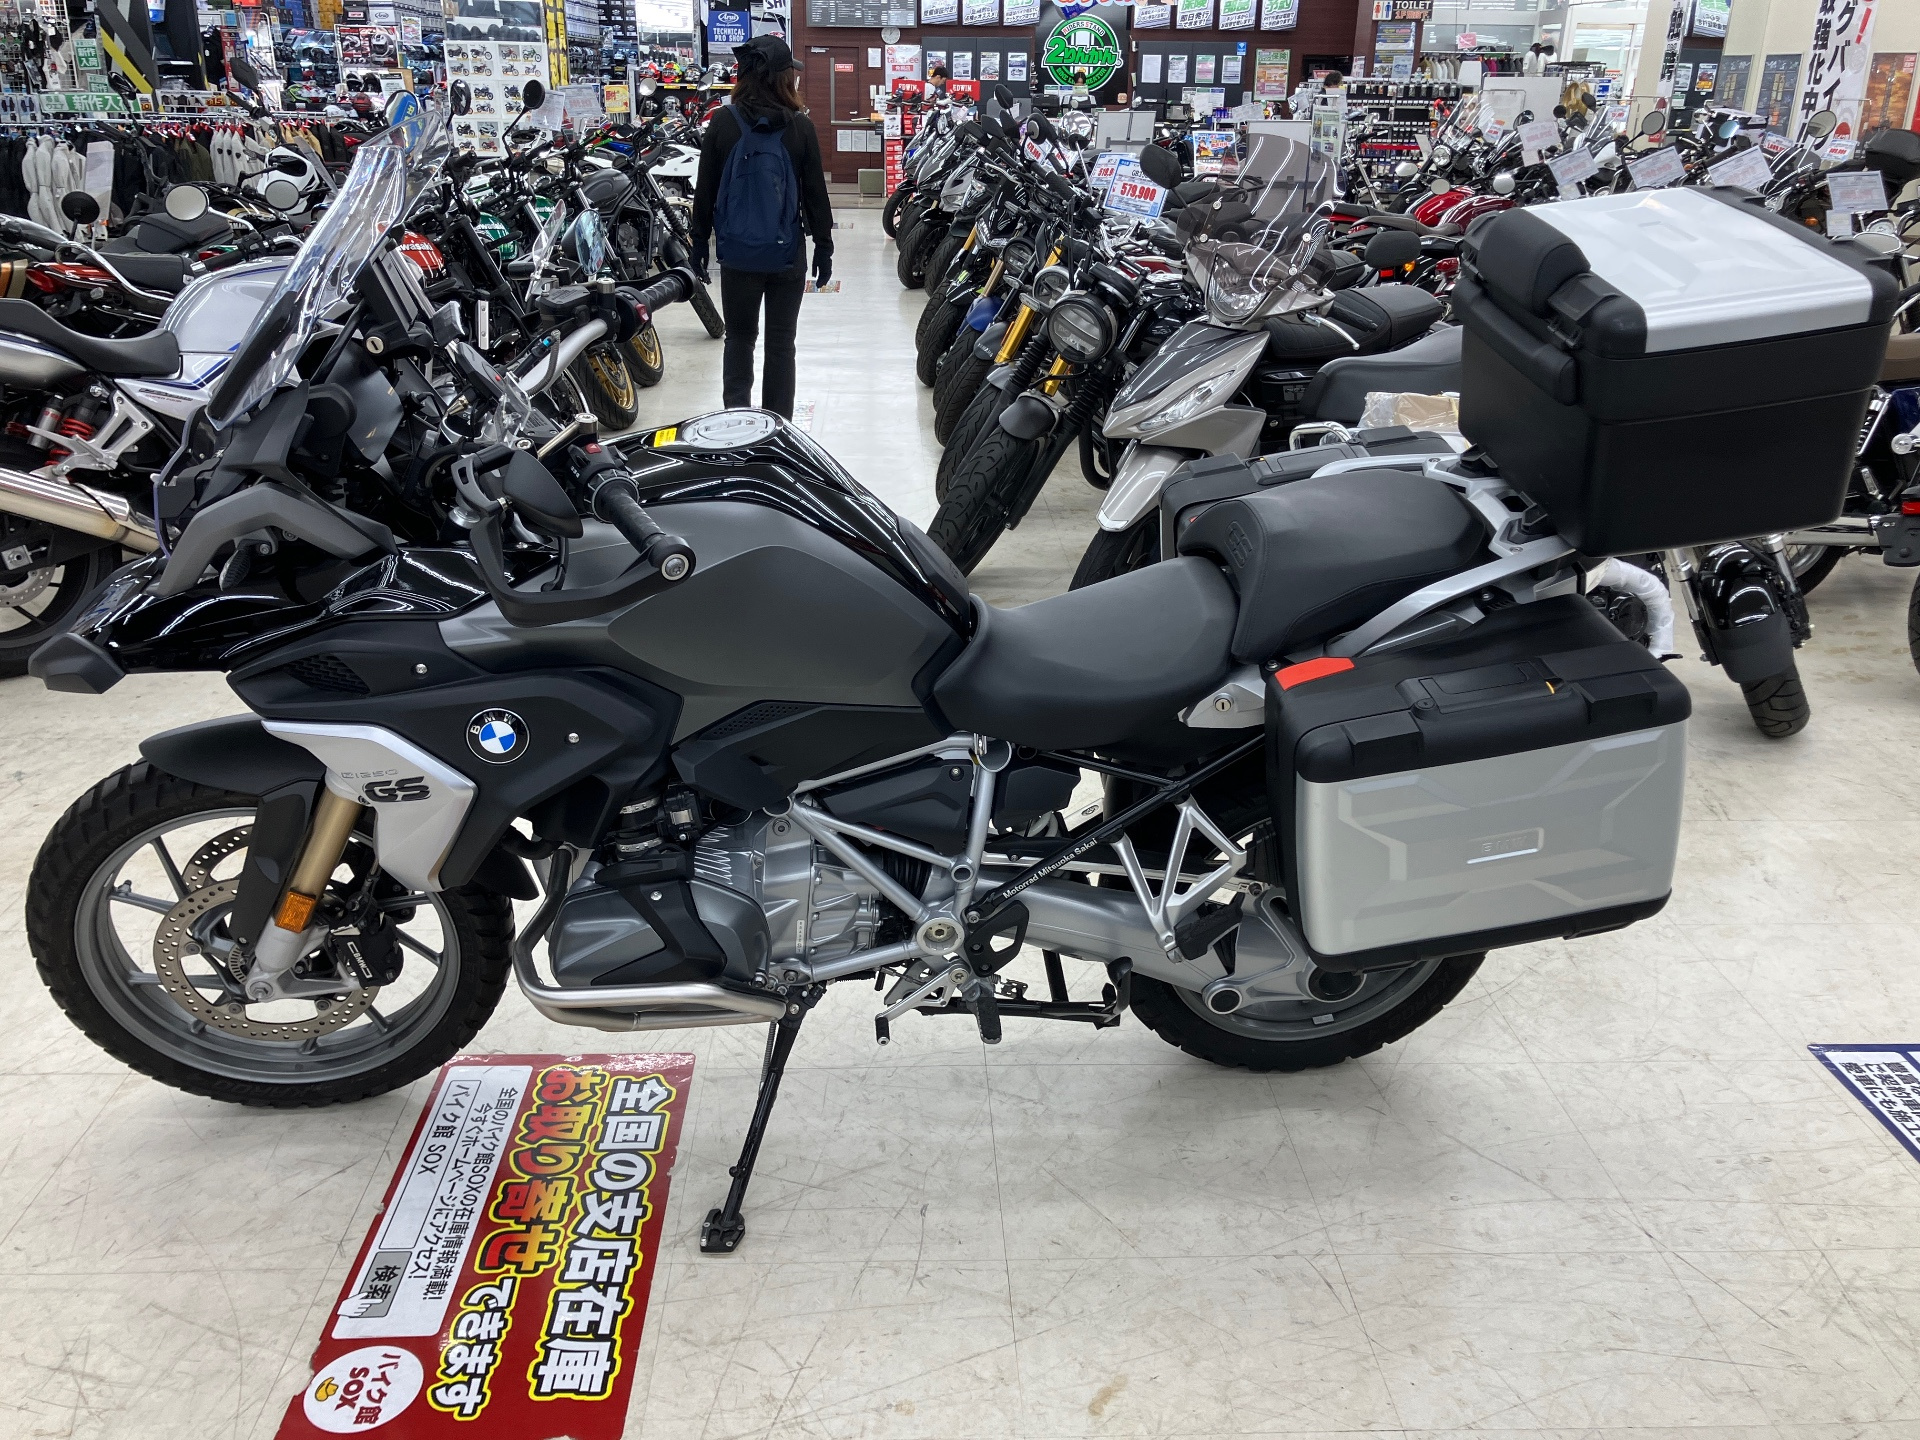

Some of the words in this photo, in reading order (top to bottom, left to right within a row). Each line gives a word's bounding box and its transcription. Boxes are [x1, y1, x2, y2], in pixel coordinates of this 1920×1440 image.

[1395, 1, 1431, 9] TOILET
[1062, 22, 1085, 35] RIDERS
[1085, 22, 1105, 36] STAND
[77, 47, 96, 57] 新作
[1045, 37, 1118, 65] 2りんかん
[898, 83, 918, 92] EDWIN
[952, 84, 972, 92] EDWIN
[1120, 182, 1157, 201] 579,900
[400, 242, 433, 251] wasaki
[470, 713, 516, 735] BMW
[362, 776, 432, 803] GS
[1002, 874, 1039, 899] Motorrad
[1039, 853, 1075, 878] Mitsuoka
[1074, 838, 1098, 855] Sakai
[431, 1084, 470, 1140] バイク館
[1839, 1062, 1920, 1144] 愛車にも施工
[417, 1143, 447, 1176] SOX
[407, 1103, 493, 1280] 今すぐホームページにアクセス!
[533, 1074, 675, 1398] 全国の支店在庫
[367, 1265, 401, 1300] 検索
[334, 1366, 370, 1411] SOX
[353, 1352, 401, 1425] バイク館
